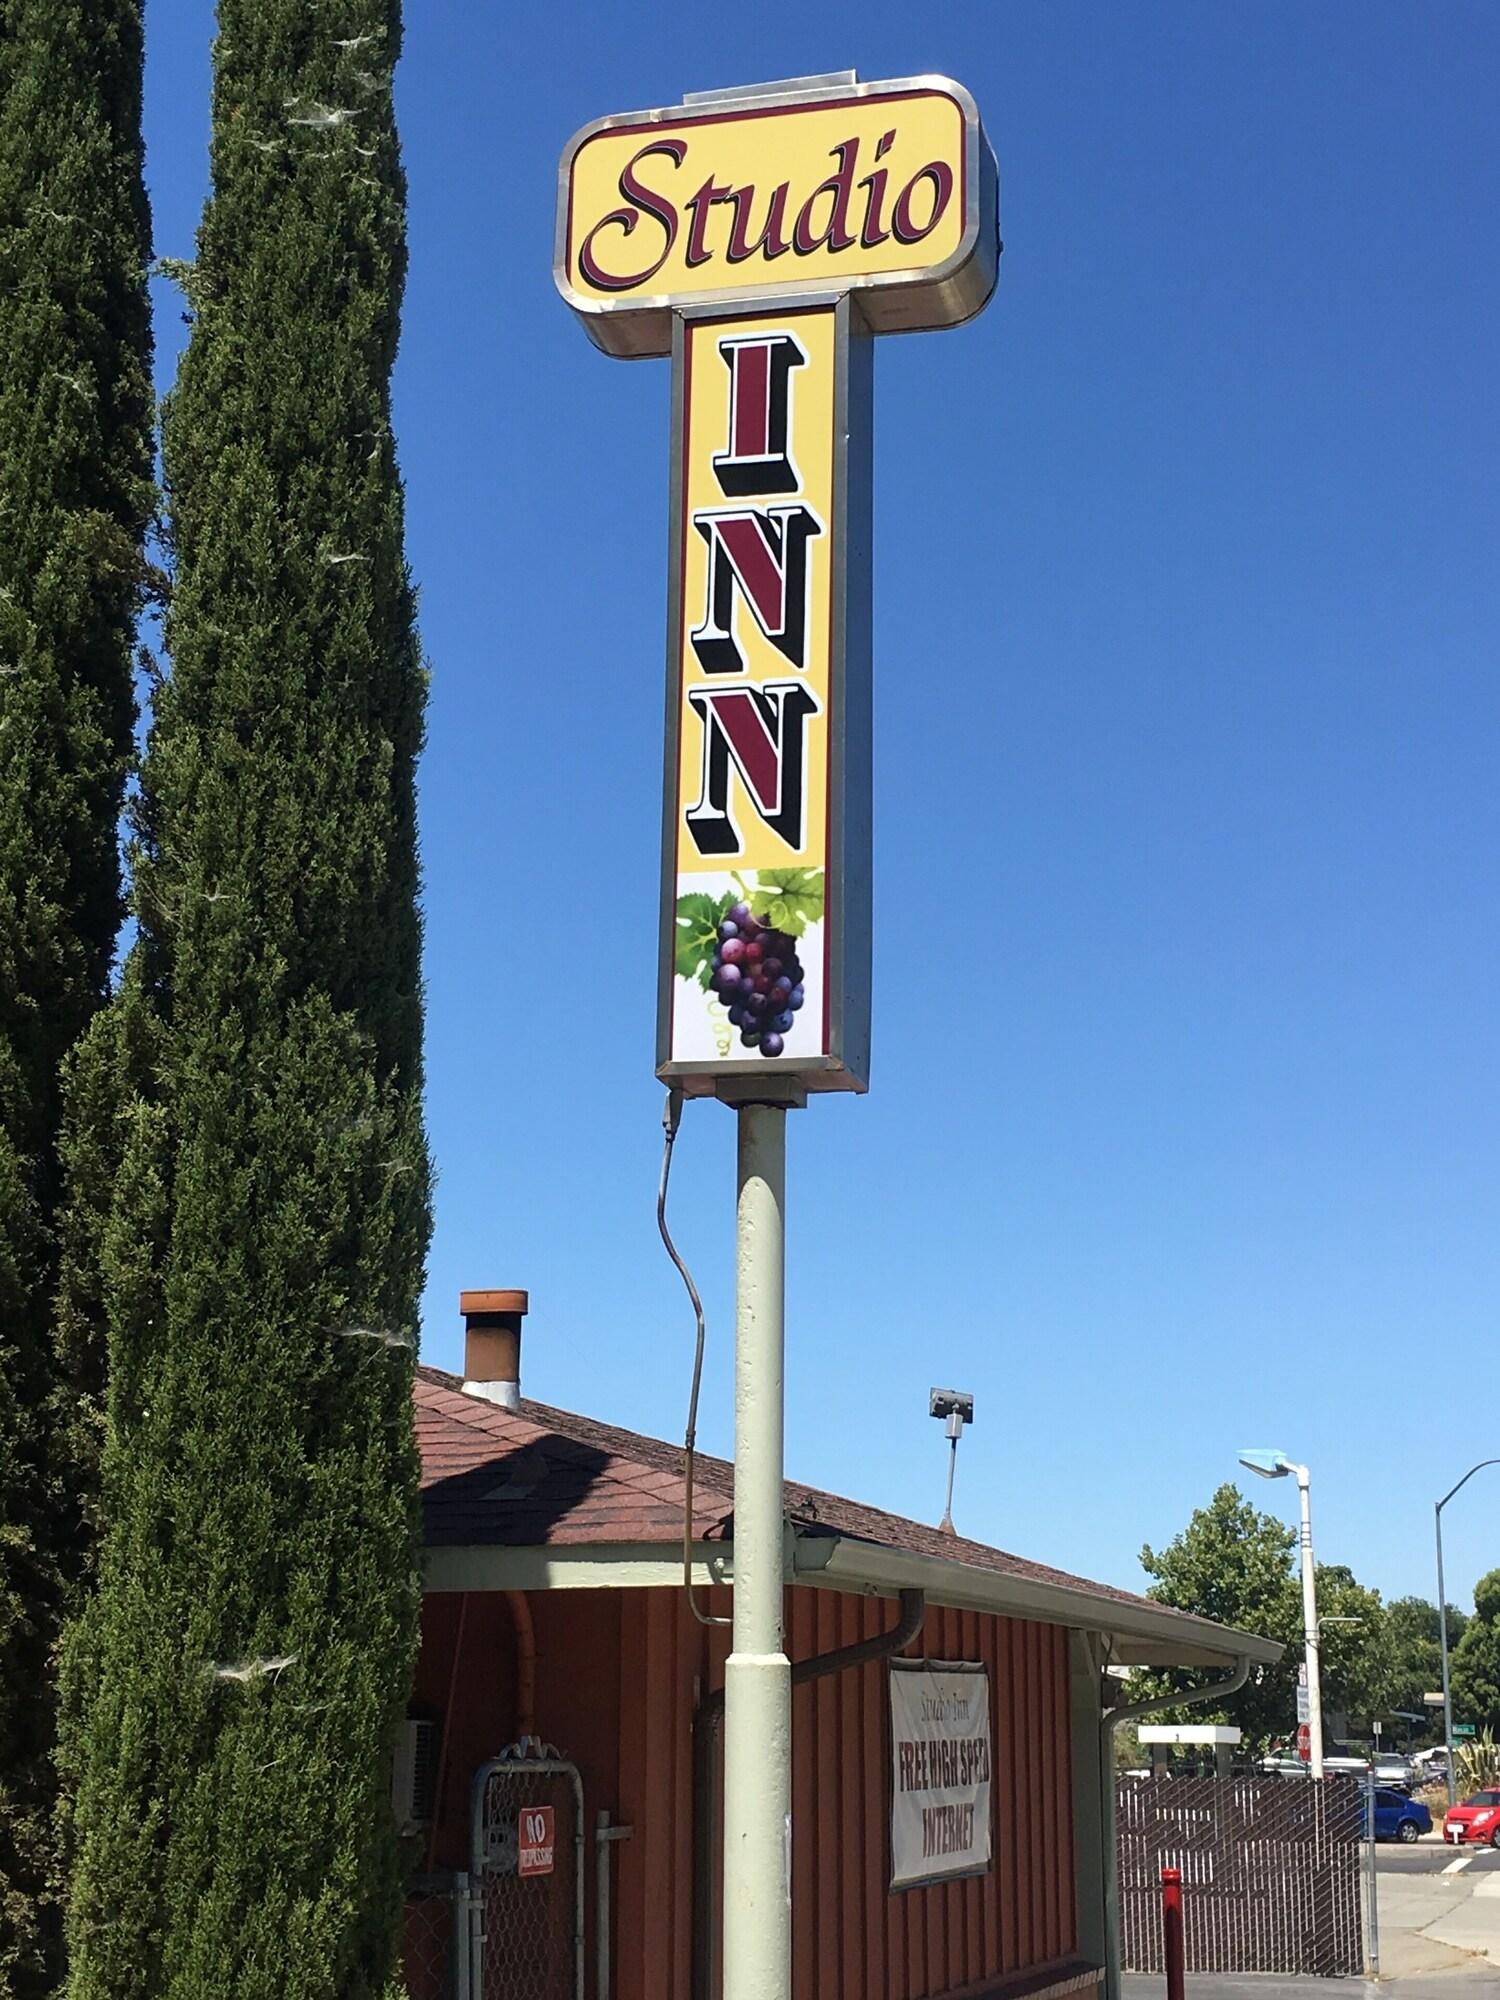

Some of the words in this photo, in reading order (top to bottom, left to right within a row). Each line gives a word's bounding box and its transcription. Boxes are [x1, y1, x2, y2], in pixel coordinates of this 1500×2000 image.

[578, 128, 954, 292] Studio
[685, 334, 826, 855] INN
[898, 1740, 928, 1792] FREE
[929, 1738, 958, 1790] HIGH
[960, 1736, 989, 1787] SPEED
[526, 1814, 546, 1844] NO
[922, 1802, 974, 1858] INTERNET
